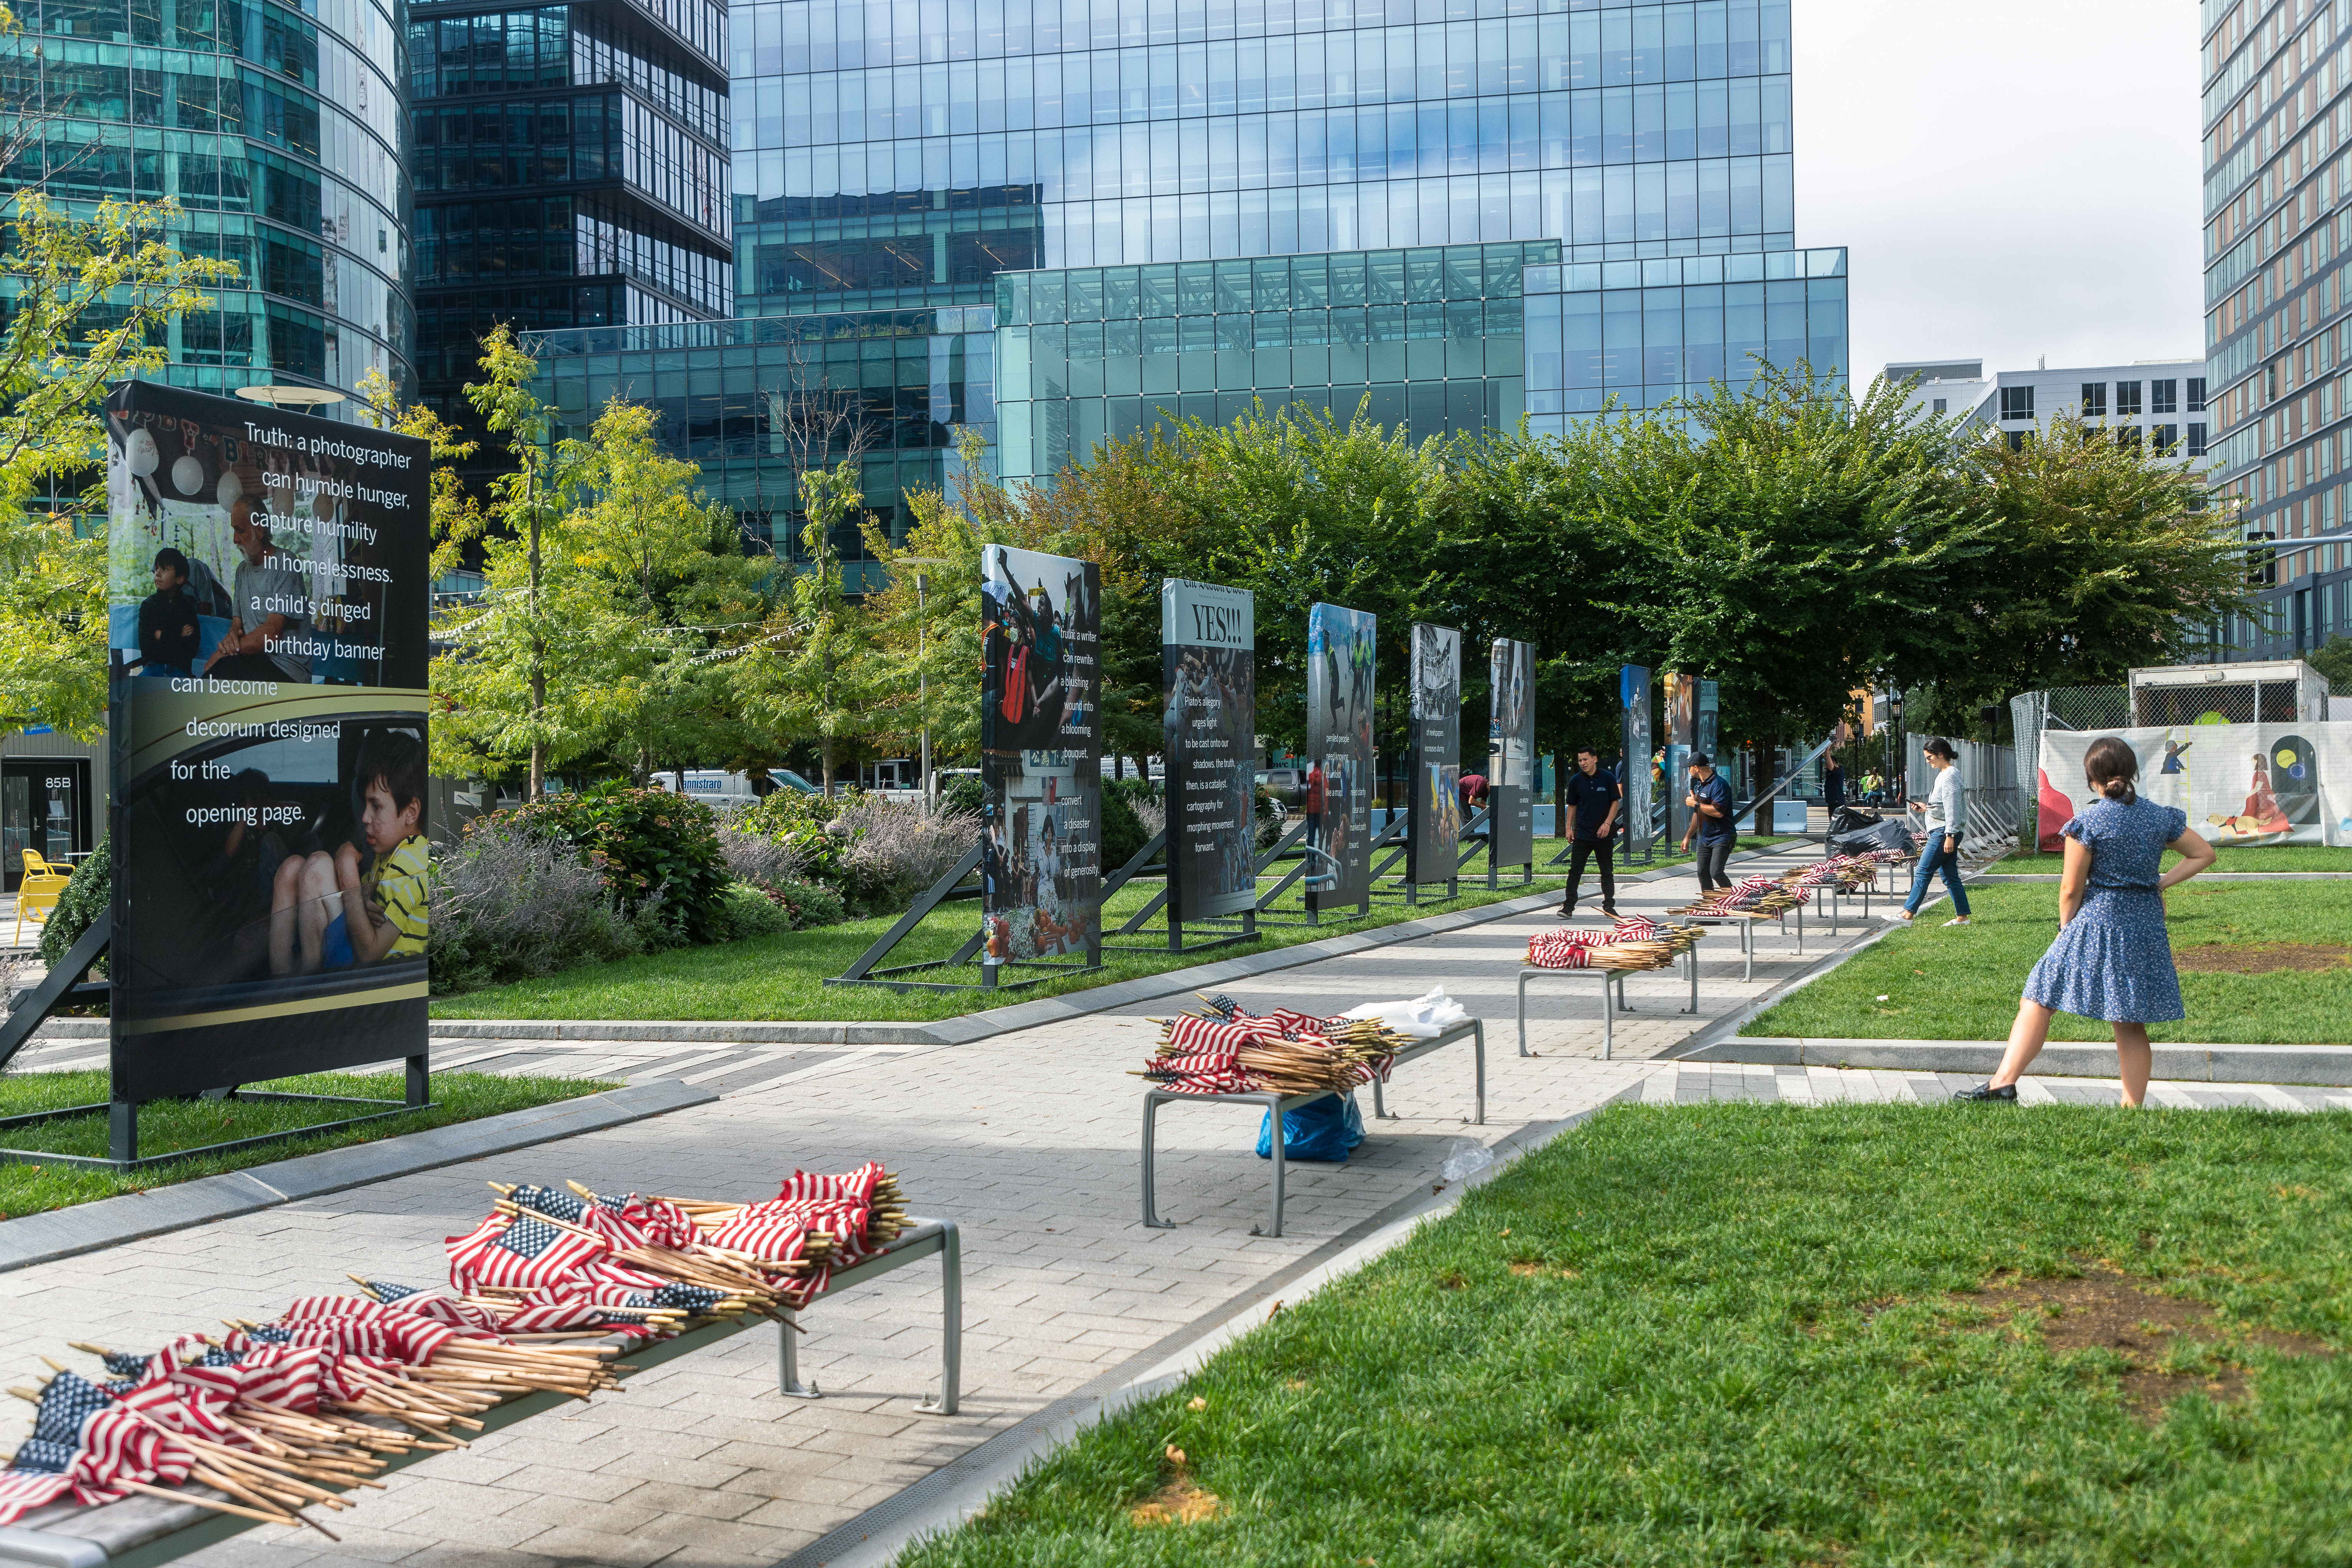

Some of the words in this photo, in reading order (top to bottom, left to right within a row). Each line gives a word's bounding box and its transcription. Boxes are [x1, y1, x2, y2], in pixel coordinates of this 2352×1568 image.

[245, 421, 293, 449] Truth:
[297, 436, 306, 450] a
[311, 435, 411, 469] photographer
[262, 472, 291, 489] can
[296, 473, 353, 499] humble
[357, 480, 410, 510] hunger,
[251, 512, 312, 533] capture
[317, 515, 377, 545] humility
[264, 552, 278, 570] in
[283, 555, 393, 583] homelessness.
[251, 597, 260, 610] a
[265, 594, 316, 615] child's
[320, 600, 370, 623] dinged
[1192, 604, 1241, 644] YES!!!
[1060, 629, 1075, 641] truth:
[1081, 631, 1096, 642] writer
[264, 634, 332, 660] birthday
[335, 642, 385, 660] banner
[1063, 654, 1073, 663] can
[1074, 654, 1093, 665] rewrite
[172, 676, 203, 694] can
[209, 675, 278, 695] become
[1061, 678, 1064, 686] a
[1065, 675, 1088, 690] blushing
[1064, 701, 1082, 711] wound
[1083, 701, 1093, 712] into
[1185, 696, 1202, 707] Plato's
[1202, 697, 1221, 709] allegory
[186, 717, 264, 737] decorum
[269, 720, 340, 742] designed
[1192, 719, 1206, 729] urges
[1207, 718, 1217, 729] light
[1066, 724, 1091, 737] blooming
[1185, 739, 1191, 748] to
[1192, 739, 1198, 748] be
[1199, 739, 1209, 748] cast
[1210, 739, 1220, 747] onto
[1326, 734, 1338, 744] periled
[1339, 734, 1349, 744] people
[1064, 746, 1088, 759] bouquet,
[1335, 752, 1349, 762] knowing
[2278, 755, 2294, 763] SEAPORT
[170, 760, 197, 779] for
[202, 761, 230, 779] the
[1193, 759, 1215, 769] shadows.
[1224, 758, 1235, 768] truth,
[46, 777, 71, 788] 85B
[684, 777, 722, 789] annistraro
[1186, 780, 1199, 790] then,
[1200, 781, 1204, 789] is
[1209, 779, 1227, 790] catalyst.
[1335, 790, 1343, 798] map,
[1358, 788, 1366, 797] clarity
[1061, 795, 1082, 806] convert
[1187, 801, 1216, 813] cartography
[186, 804, 257, 826] opening
[263, 806, 306, 826] page.
[1069, 818, 1090, 829] disaster
[1187, 821, 1211, 834] morphing
[1212, 820, 1234, 829] movement
[1349, 823, 1360, 831] marked
[1061, 843, 1072, 853] into
[1078, 841, 1096, 855] display
[1195, 842, 1215, 853] forward.
[1064, 866, 1070, 877] of
[1071, 864, 1099, 879] generosity.
